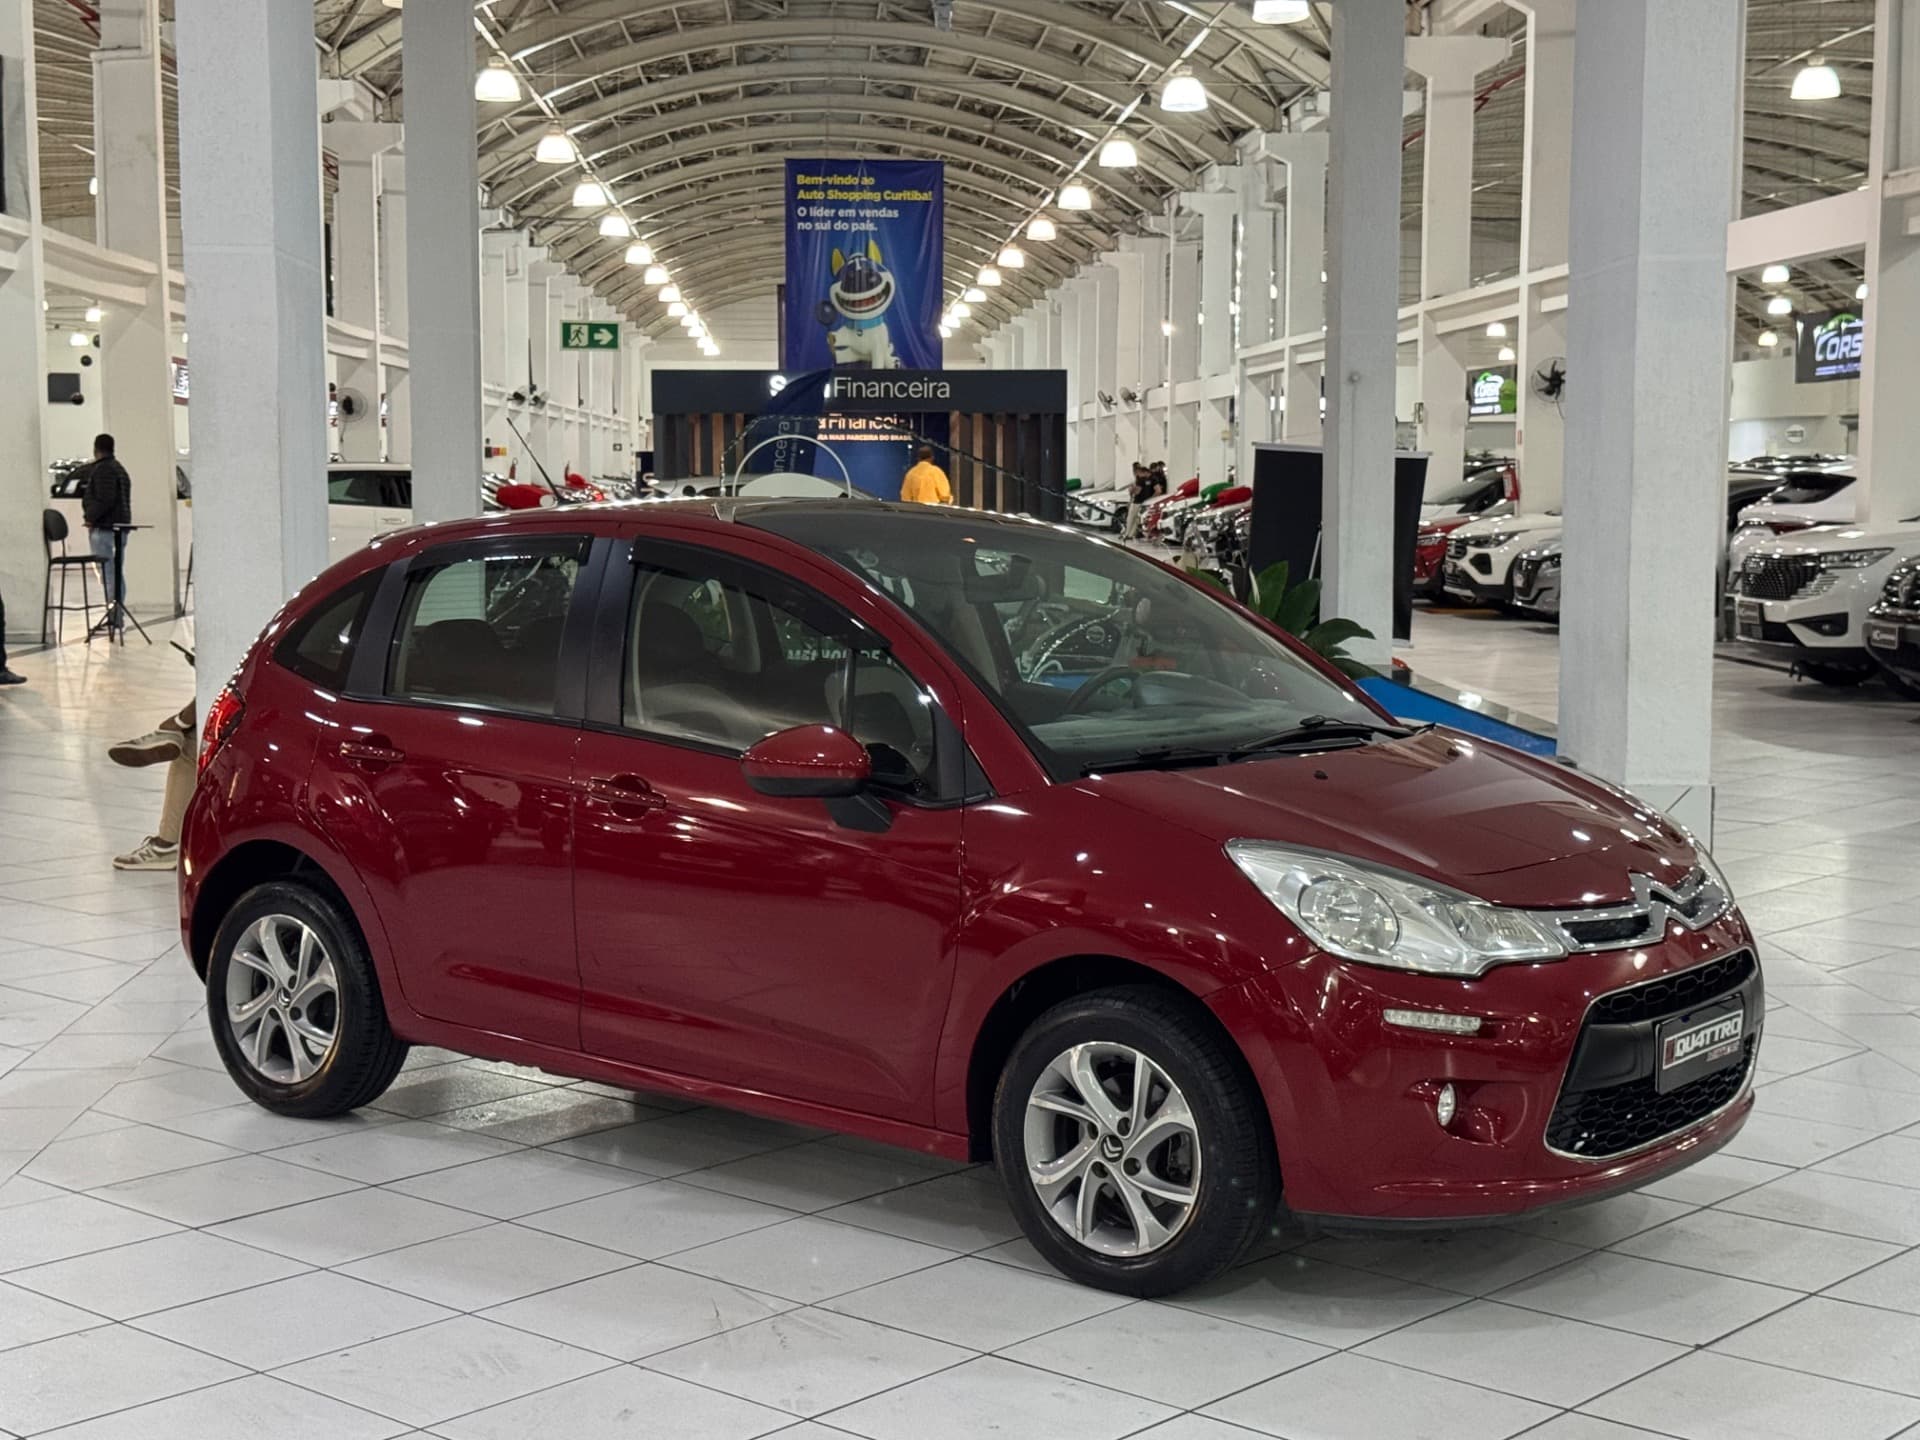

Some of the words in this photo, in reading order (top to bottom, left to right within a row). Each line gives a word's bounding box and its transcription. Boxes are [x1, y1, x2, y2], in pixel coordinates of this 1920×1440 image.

[796, 174, 859, 185] Bem-vindo
[860, 176, 875, 185] ao
[797, 189, 825, 200] Auto
[826, 189, 882, 202] Shopping
[797, 207, 807, 217] O
[809, 206, 837, 217] líder
[838, 208, 856, 217] em
[858, 208, 899, 218] vendas
[797, 221, 812, 230] no
[815, 220, 831, 230] sul
[833, 221, 848, 231] do
[833, 376, 950, 399] Financeira
